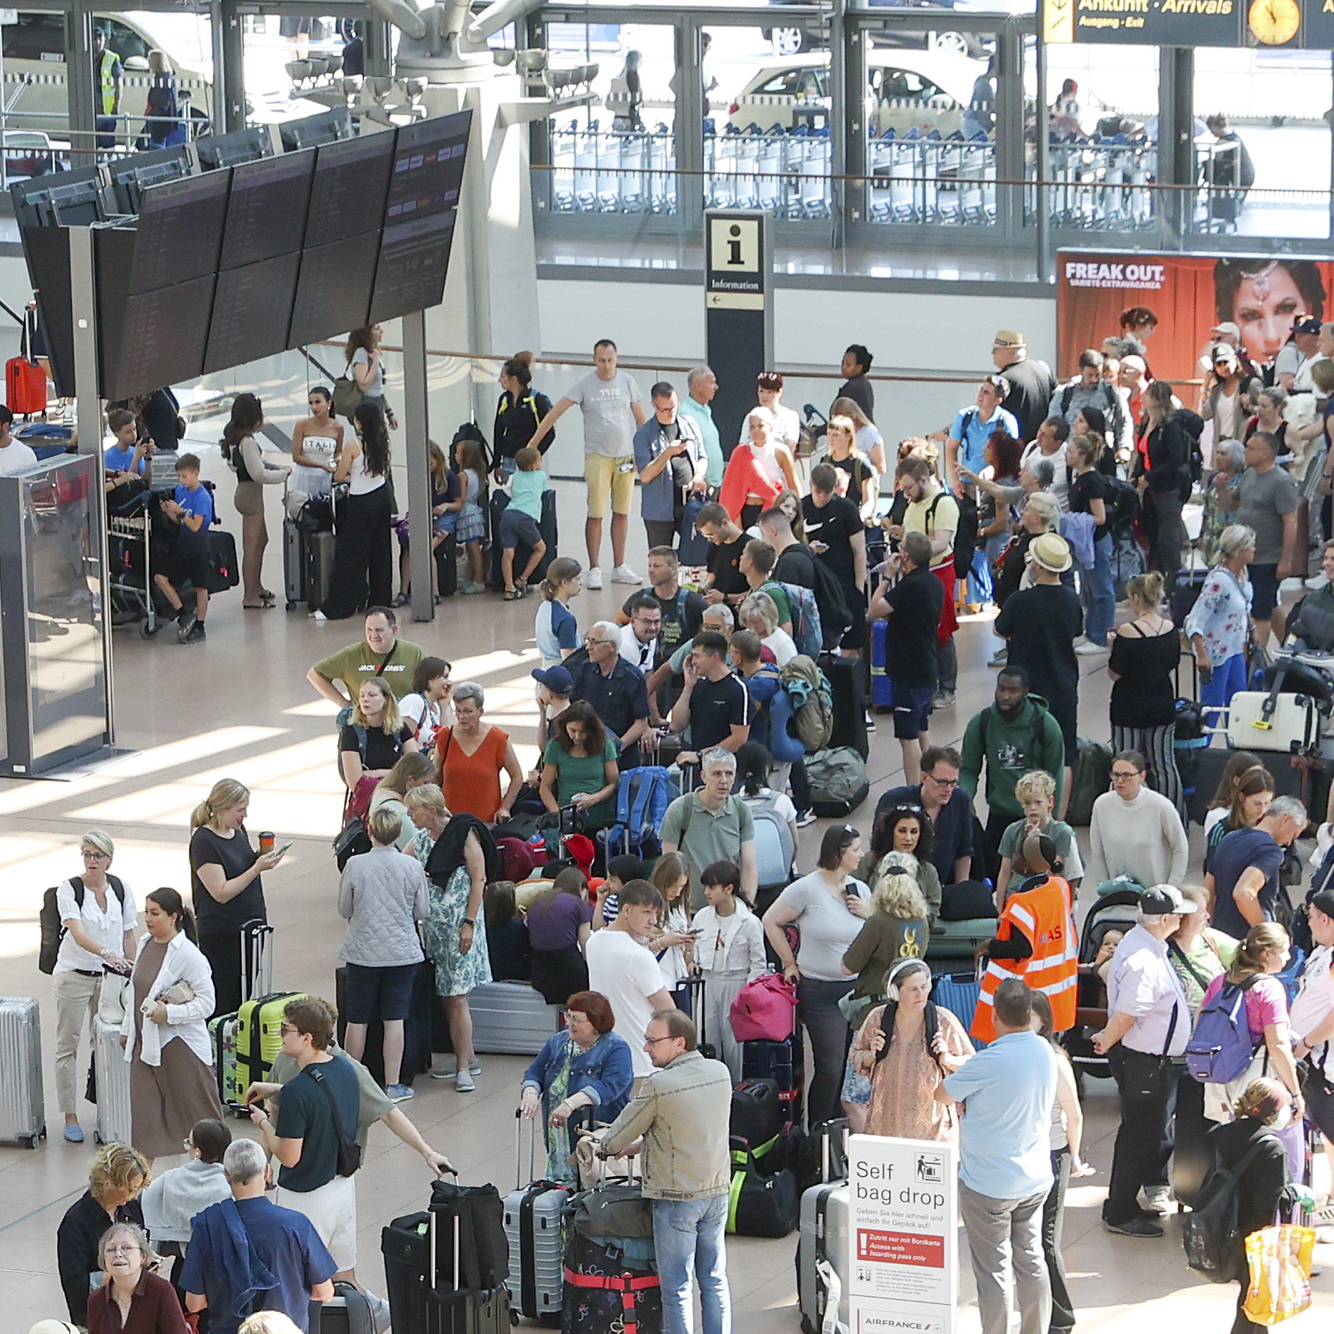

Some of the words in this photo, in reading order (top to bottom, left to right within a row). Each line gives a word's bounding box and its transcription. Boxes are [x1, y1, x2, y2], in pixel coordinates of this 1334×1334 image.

[1161, 0, 1233, 14] Arrivals
[1079, 16, 1120, 29] Ausgang
[1124, 16, 1145, 28] Exit
[1066, 262, 1124, 280] FREAK
[712, 279, 758, 290] Information
[856, 1160, 894, 1180] Self
[857, 1182, 892, 1206] bag
[899, 1186, 945, 1210] drop
[892, 1220, 916, 1228] Gepäck
[912, 1238, 941, 1246] Bordkarte
[870, 1250, 896, 1259] boarding
[898, 1254, 912, 1262] pass
[865, 1318, 922, 1330] AIRFRANCE
